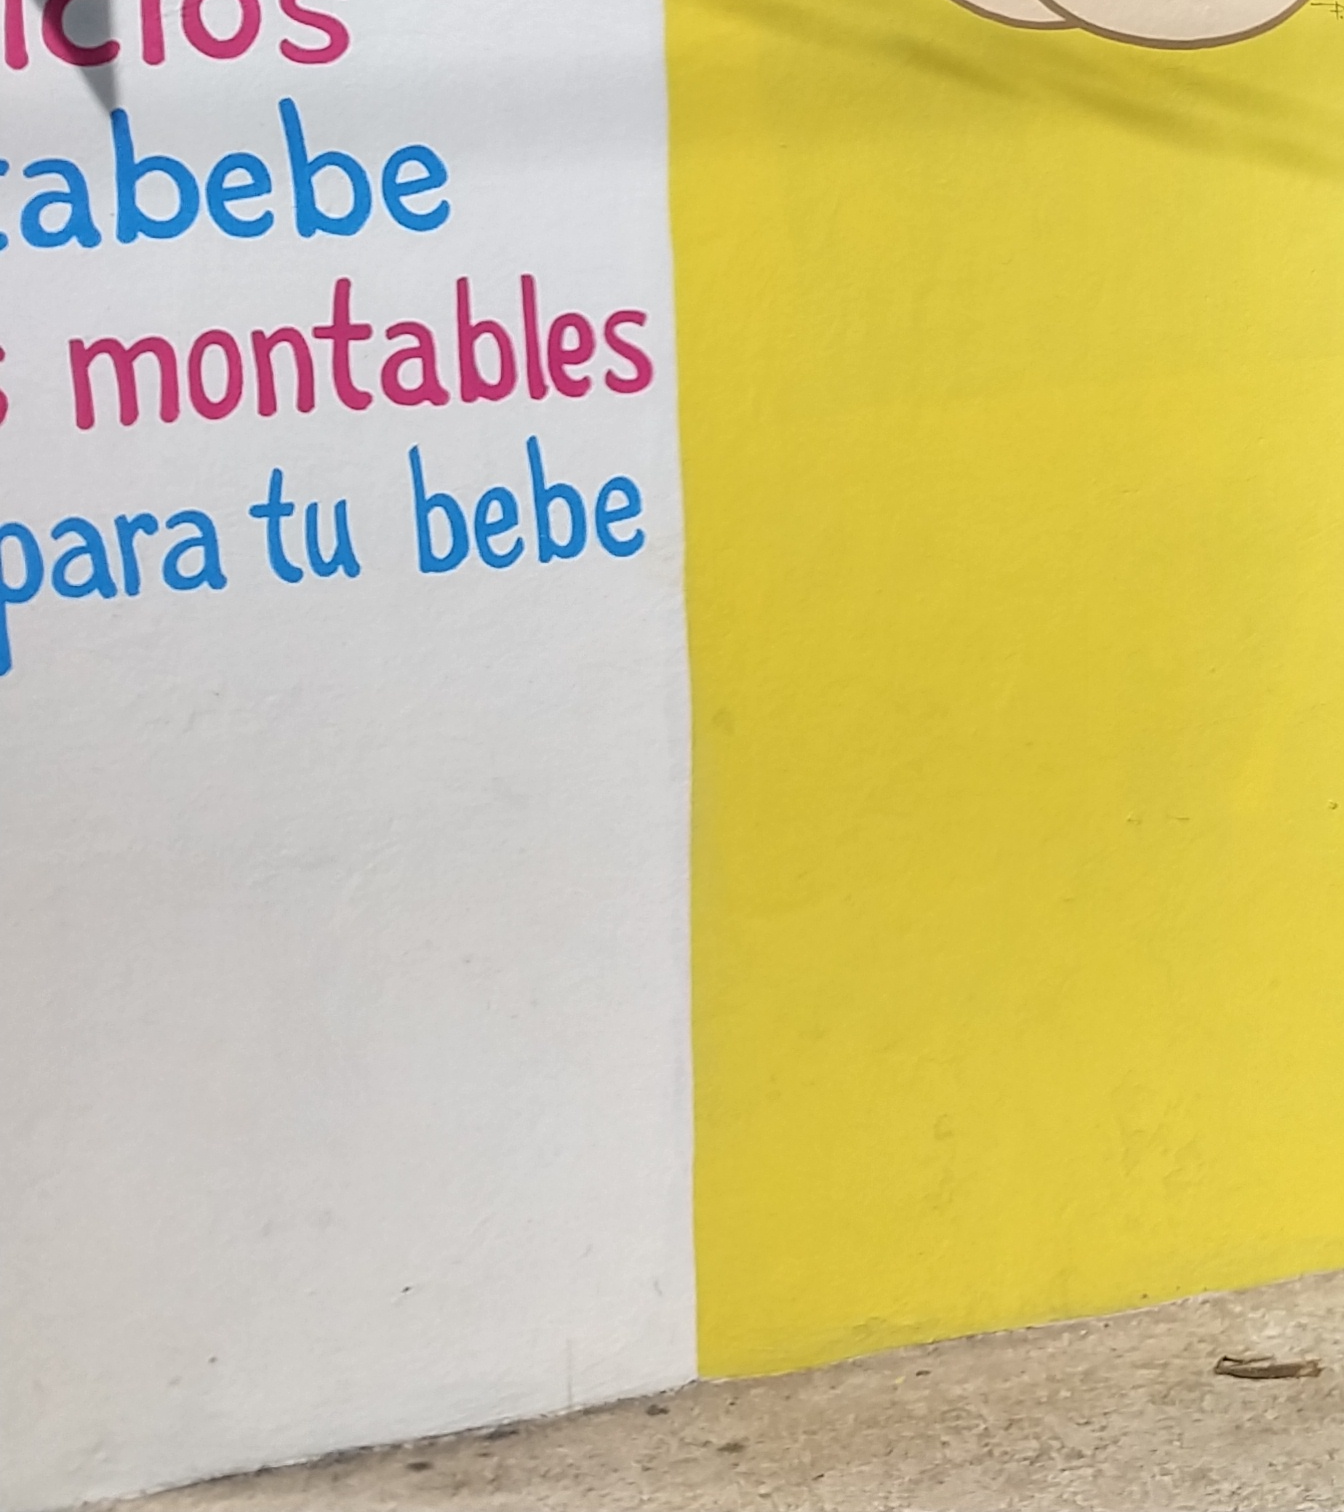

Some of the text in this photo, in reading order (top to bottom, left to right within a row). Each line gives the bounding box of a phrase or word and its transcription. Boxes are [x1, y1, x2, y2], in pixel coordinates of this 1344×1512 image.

[0, 98, 451, 251] abebe
[69, 275, 654, 430] montables
[0, 436, 645, 677] para tu bebe
